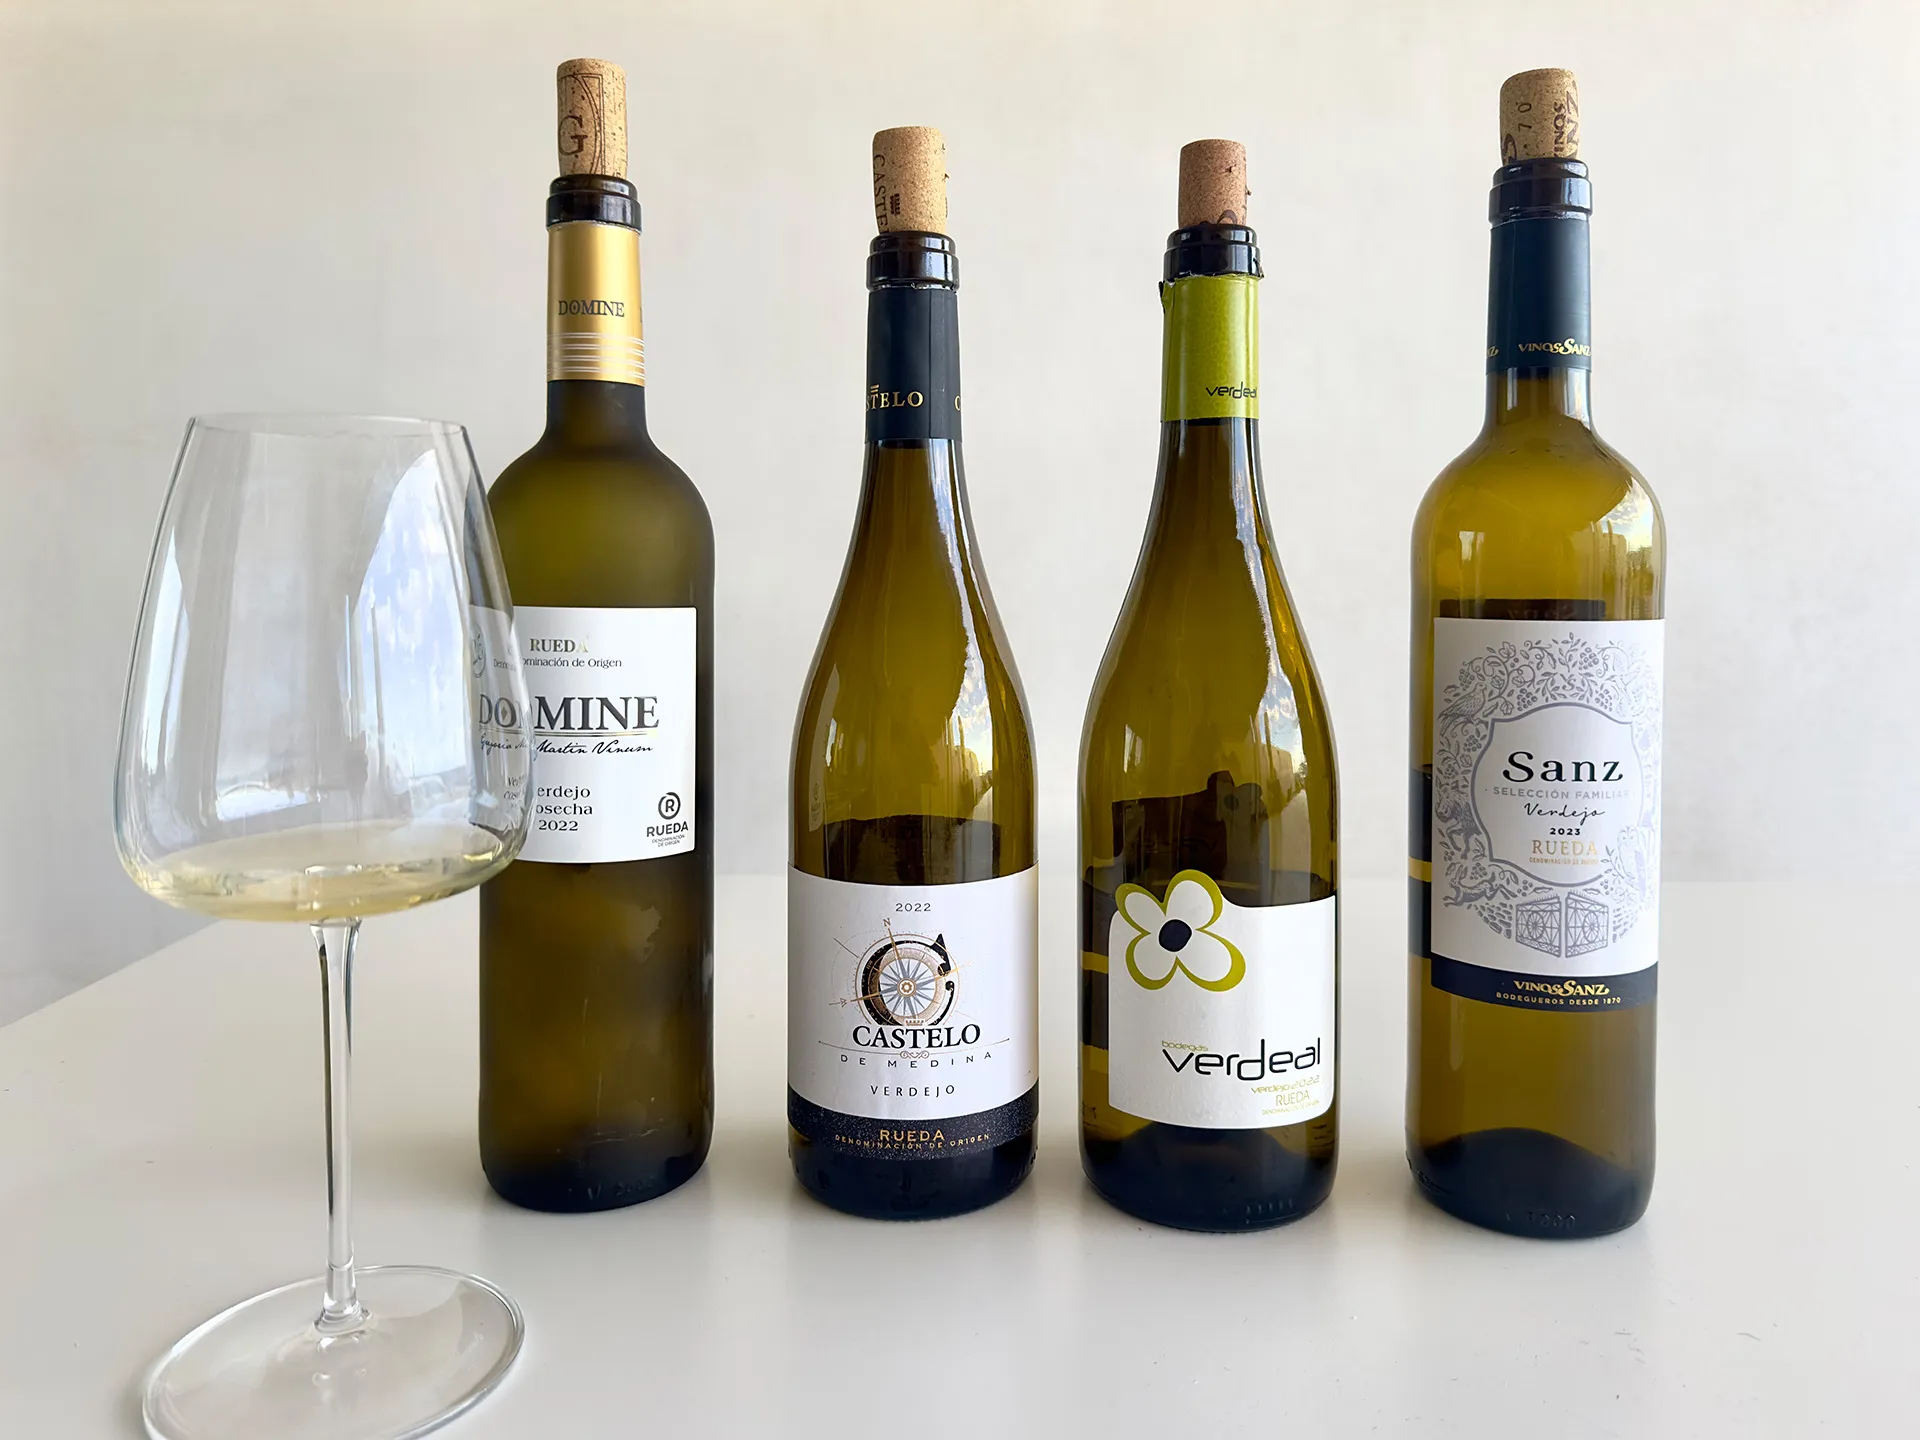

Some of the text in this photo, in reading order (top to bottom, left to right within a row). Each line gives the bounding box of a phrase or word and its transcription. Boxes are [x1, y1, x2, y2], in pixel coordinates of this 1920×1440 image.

[1553, 102, 1566, 158] INOS
[873, 154, 889, 233] CASTE
[558, 300, 625, 317] DOMINE
[530, 638, 588, 652] RUEDA
[572, 658, 585, 667] de
[589, 658, 622, 668] Origen
[1502, 751, 1624, 783] Sanz
[537, 785, 591, 801] erdejo
[1493, 786, 1569, 800] SELECCIÓN
[535, 803, 593, 815] osecha
[1524, 802, 1606, 826] Verdejo
[539, 819, 579, 831] 2022
[646, 821, 689, 837] RUEDA
[1549, 827, 1581, 836] 2023
[1532, 839, 1598, 857] RUEDA
[895, 902, 932, 912] 2022
[1496, 991, 1621, 1006] BODEGUEROS DESDE 1870
[852, 1024, 981, 1049] CASTELO
[840, 1051, 992, 1069] DE MEDINA
[1162, 1037, 1320, 1081] verdeal
[870, 1084, 956, 1097] VERDEJO
[1275, 1089, 1310, 1107] RUEDA
[835, 1134, 922, 1150] DENOMINACIÓN
[949, 1133, 990, 1147] ORIGEN
[879, 1129, 945, 1142] RUEDA
